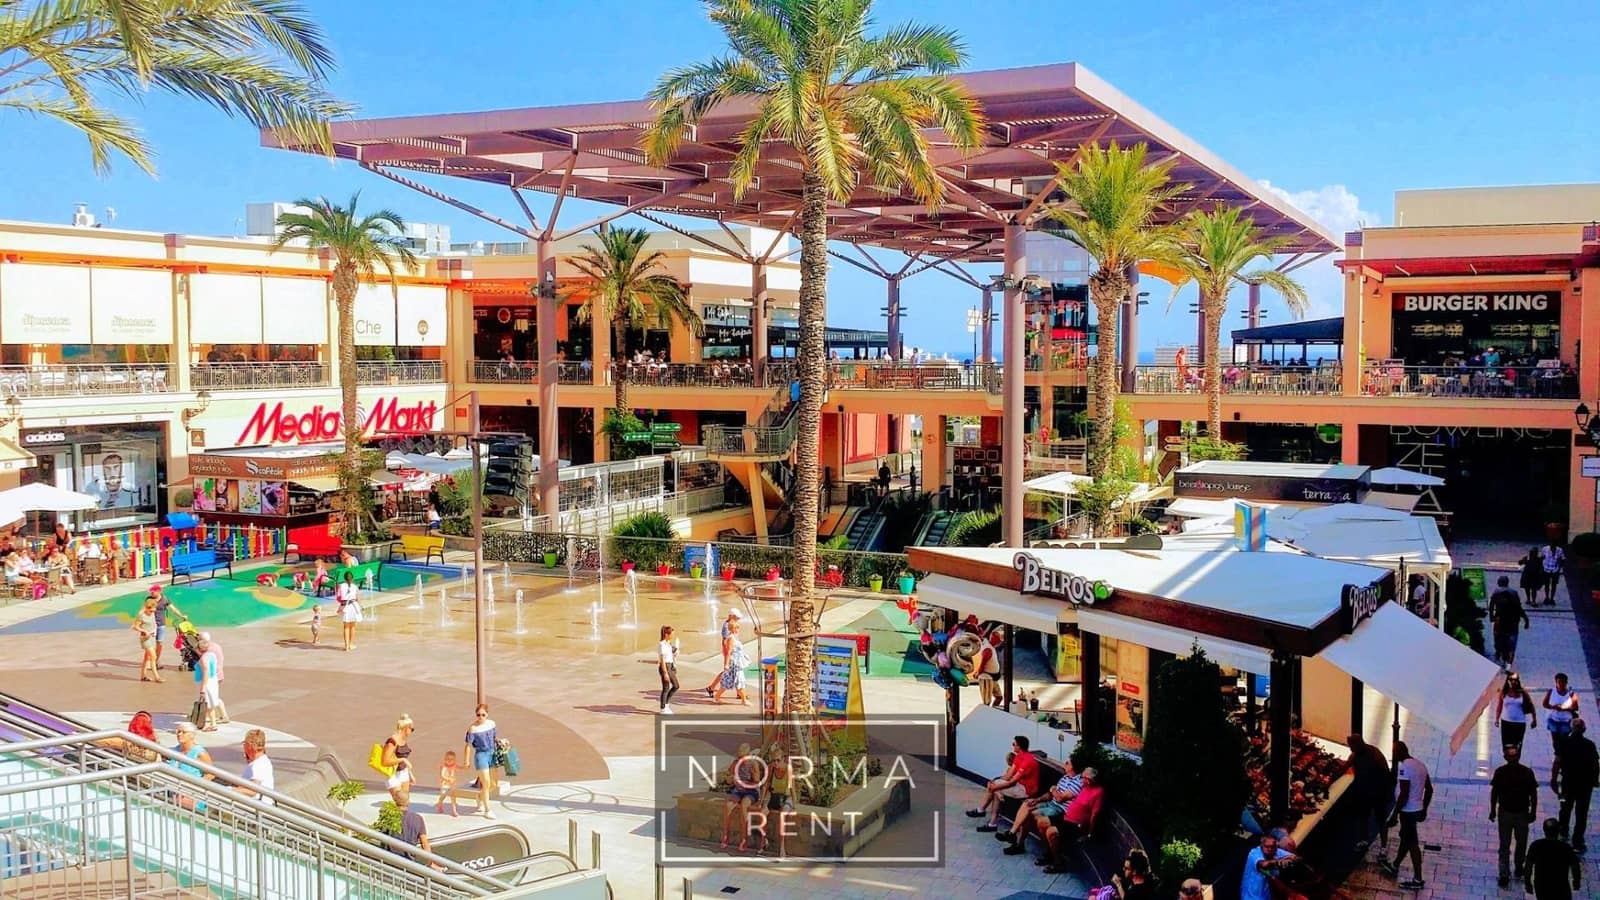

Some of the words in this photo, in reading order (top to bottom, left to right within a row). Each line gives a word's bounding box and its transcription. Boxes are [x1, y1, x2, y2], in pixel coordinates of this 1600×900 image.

[1404, 295, 1488, 311] BURGER
[1493, 294, 1548, 311] KING
[355, 319, 382, 335] Che
[234, 402, 340, 446] Media
[364, 396, 437, 432] Markt
[25, 430, 66, 443] adidas
